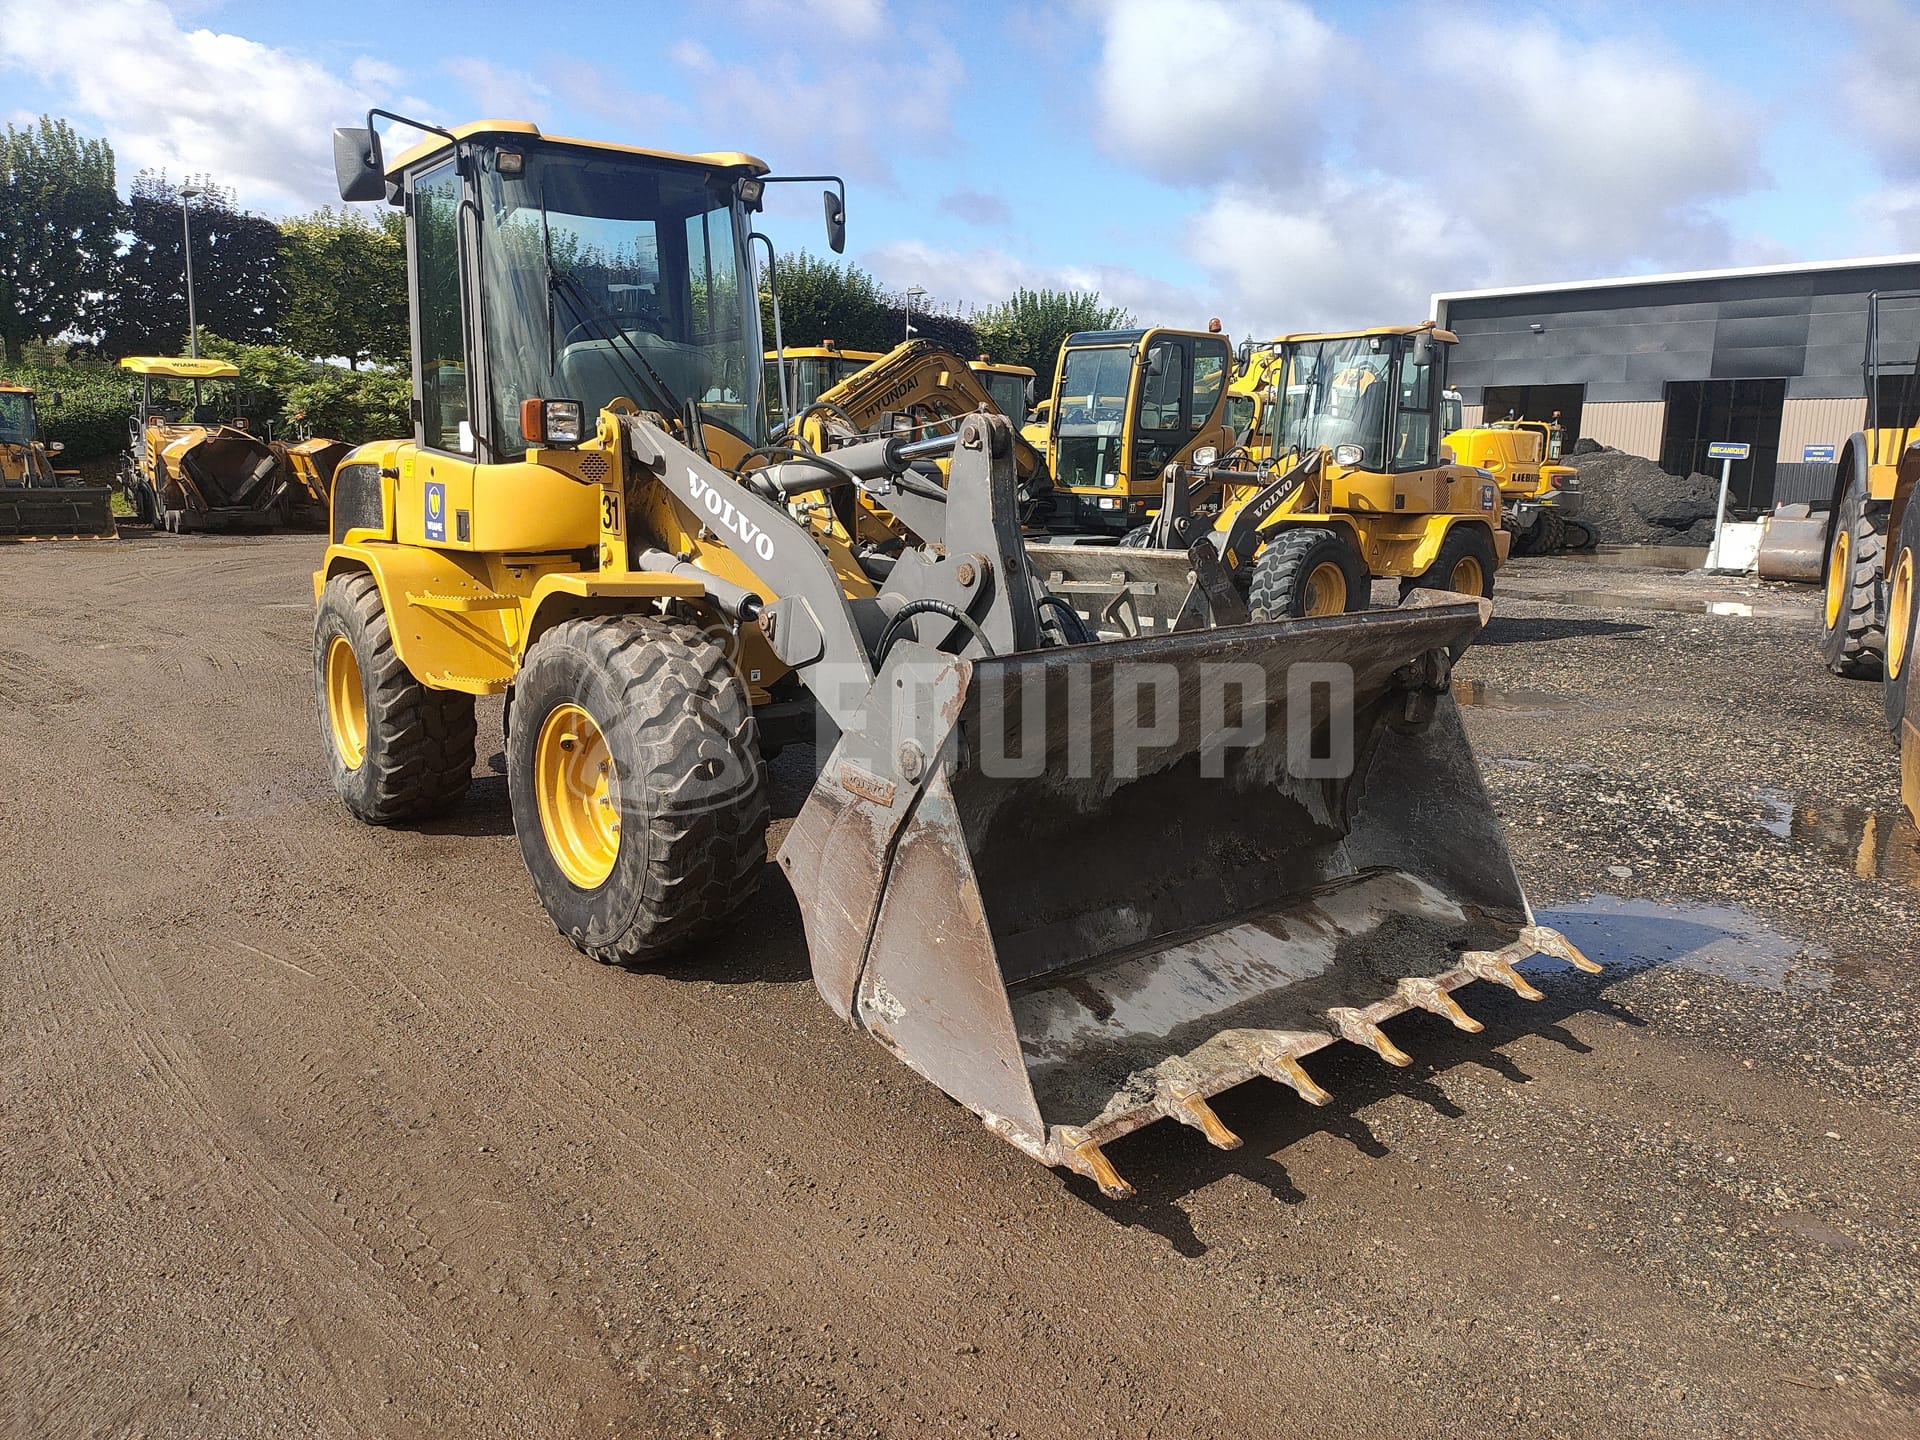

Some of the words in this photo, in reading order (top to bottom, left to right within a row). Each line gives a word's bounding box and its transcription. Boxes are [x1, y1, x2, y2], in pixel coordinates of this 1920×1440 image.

[864, 375, 919, 419] HYUNDAI
[602, 494, 619, 531] 31
[687, 467, 775, 561] VOLVO
[1253, 479, 1293, 518] VOLVO
